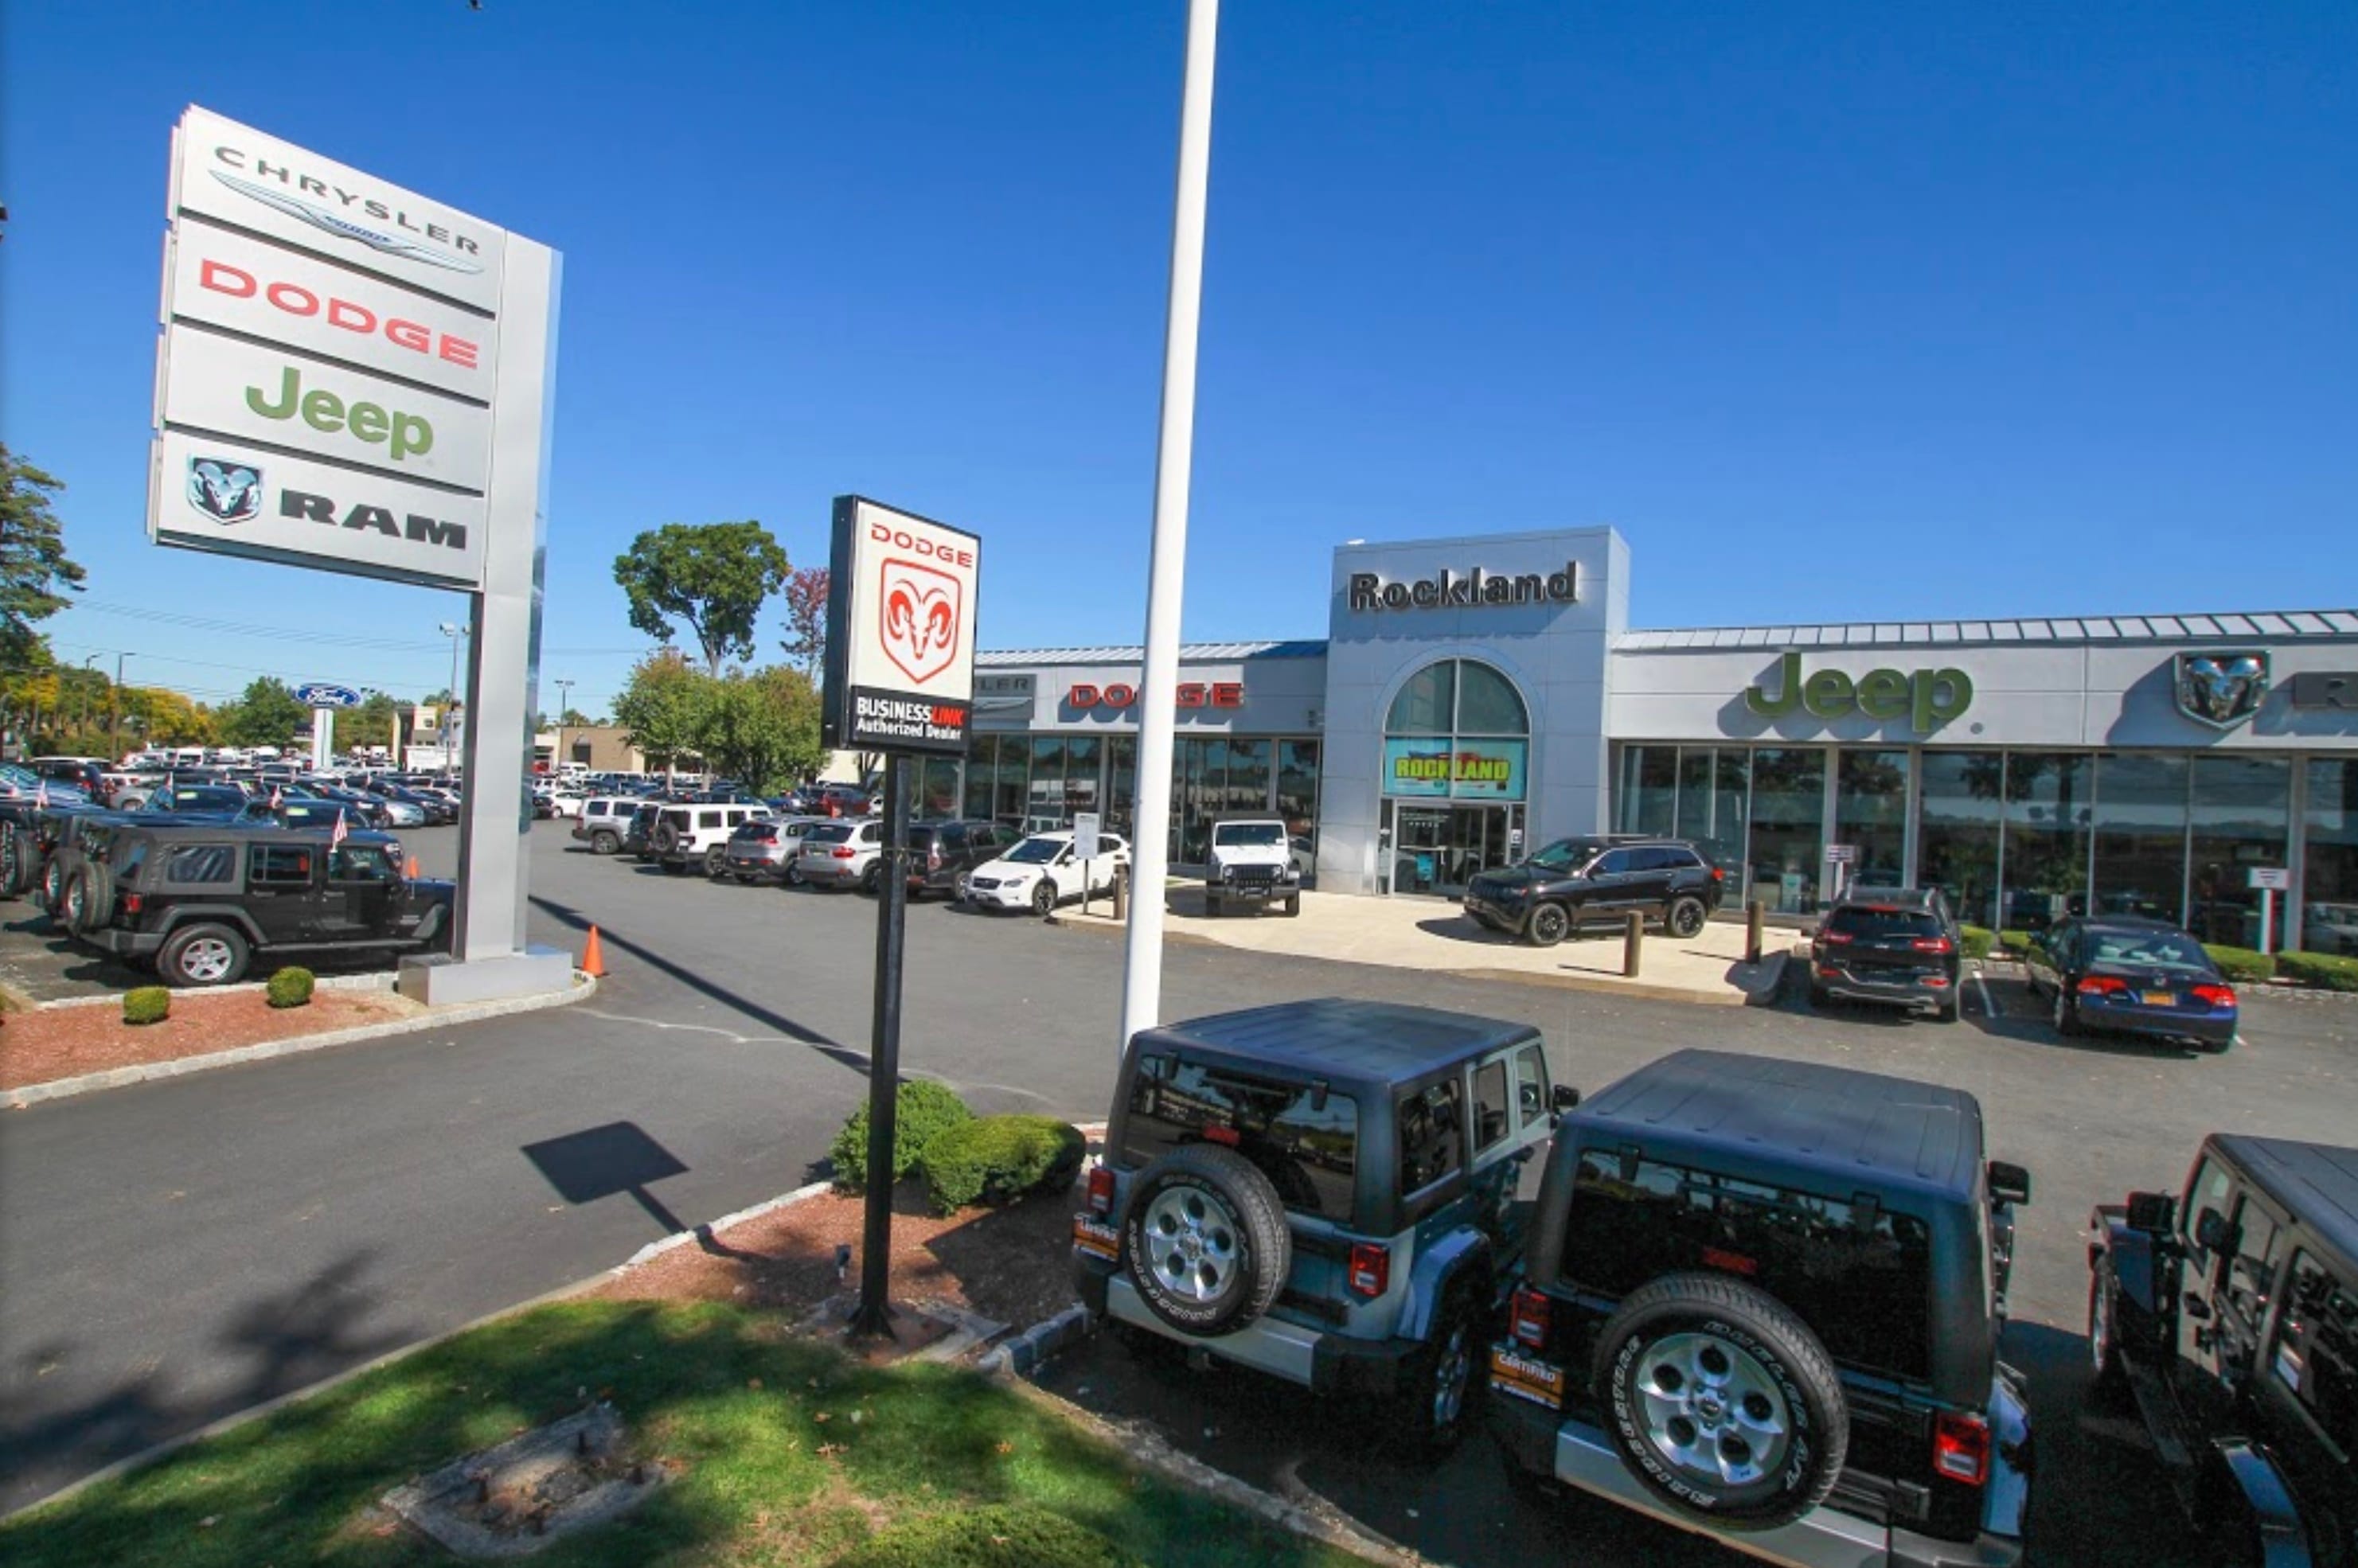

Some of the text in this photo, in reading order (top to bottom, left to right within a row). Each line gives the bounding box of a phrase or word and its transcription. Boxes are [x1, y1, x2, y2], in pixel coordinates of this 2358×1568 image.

[213, 145, 479, 256] CHRYSLER
[200, 259, 478, 369] DODGE
[245, 366, 434, 461] Jeep
[279, 488, 468, 550] RAM
[871, 522, 973, 569] DODGE
[1349, 560, 1579, 610] Rockland
[306, 687, 346, 705] Ford
[1069, 682, 1244, 709] DOGE
[1745, 652, 1974, 733] Jeep
[857, 717, 961, 740] Authorized Dealer
